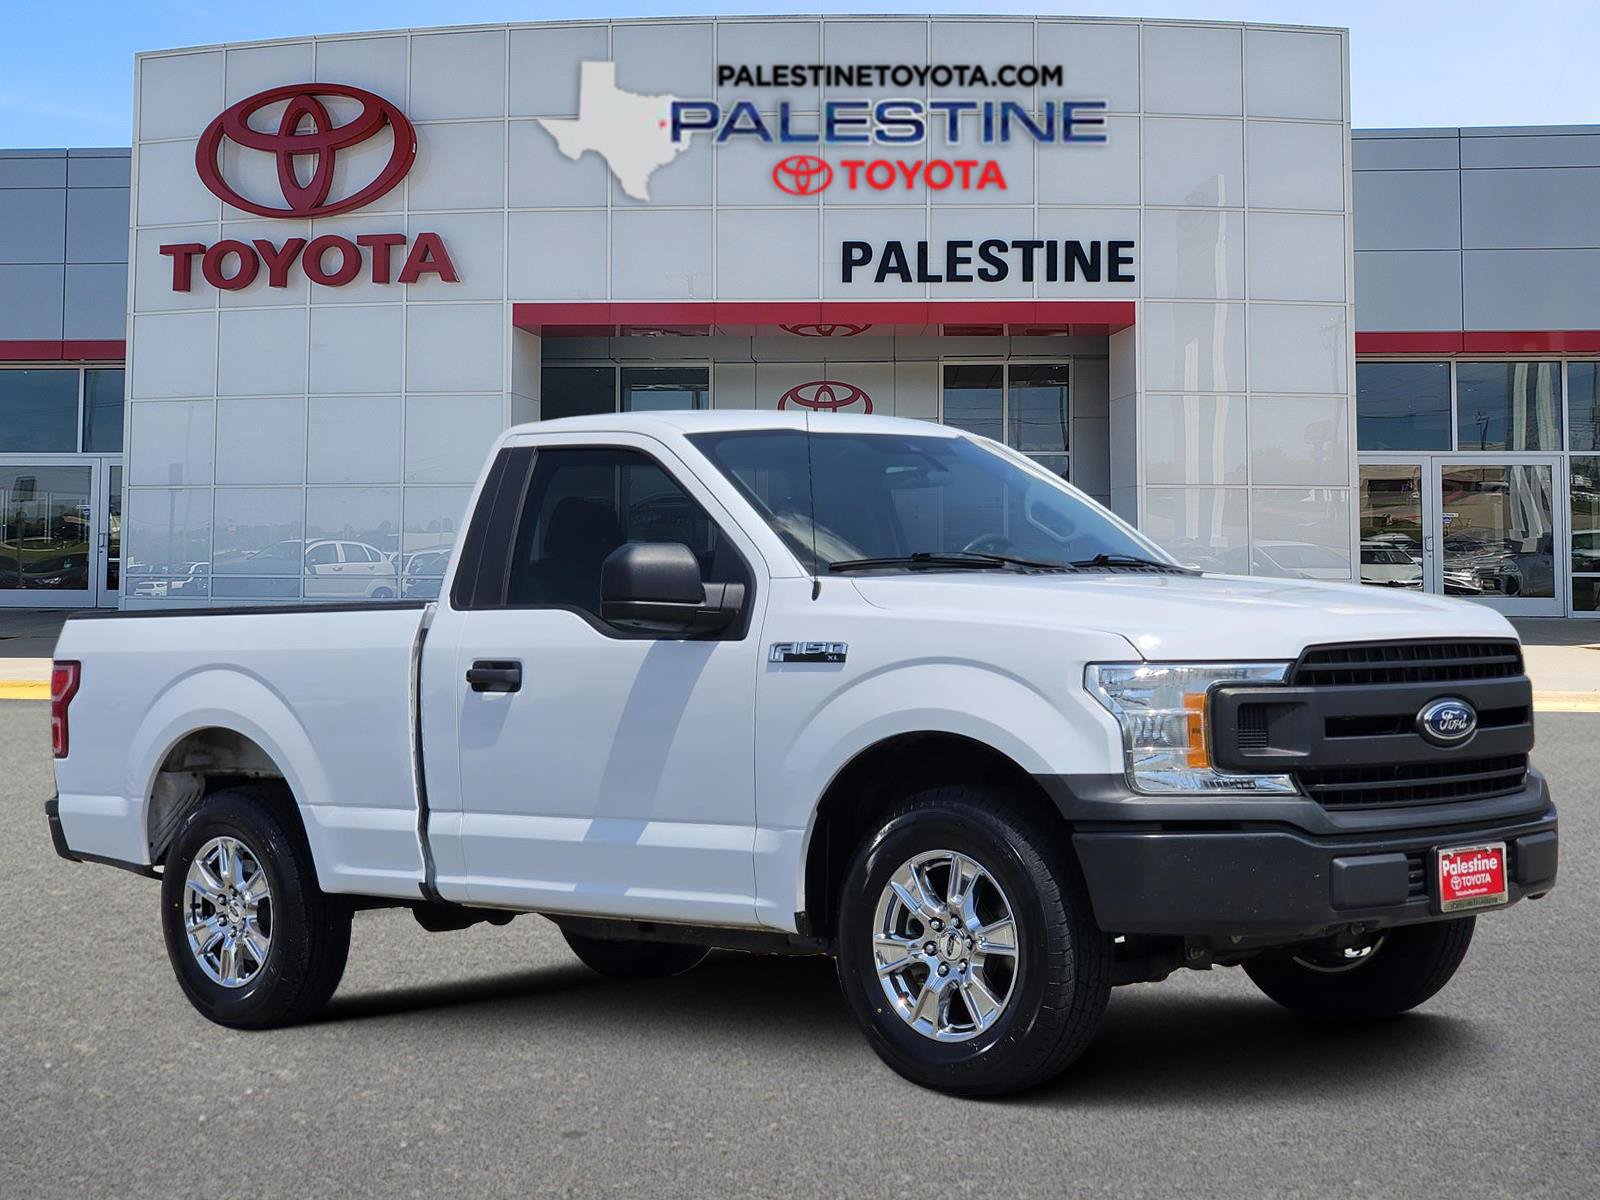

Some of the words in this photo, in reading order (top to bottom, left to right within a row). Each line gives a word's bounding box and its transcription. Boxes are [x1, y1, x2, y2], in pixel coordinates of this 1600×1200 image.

[159, 232, 461, 292] TOYOTA
[841, 240, 1136, 284] PALESTINE
[1439, 709, 1468, 731] Ford
[1442, 854, 1498, 876] Palestine
[1462, 873, 1491, 887] TOYOTA
